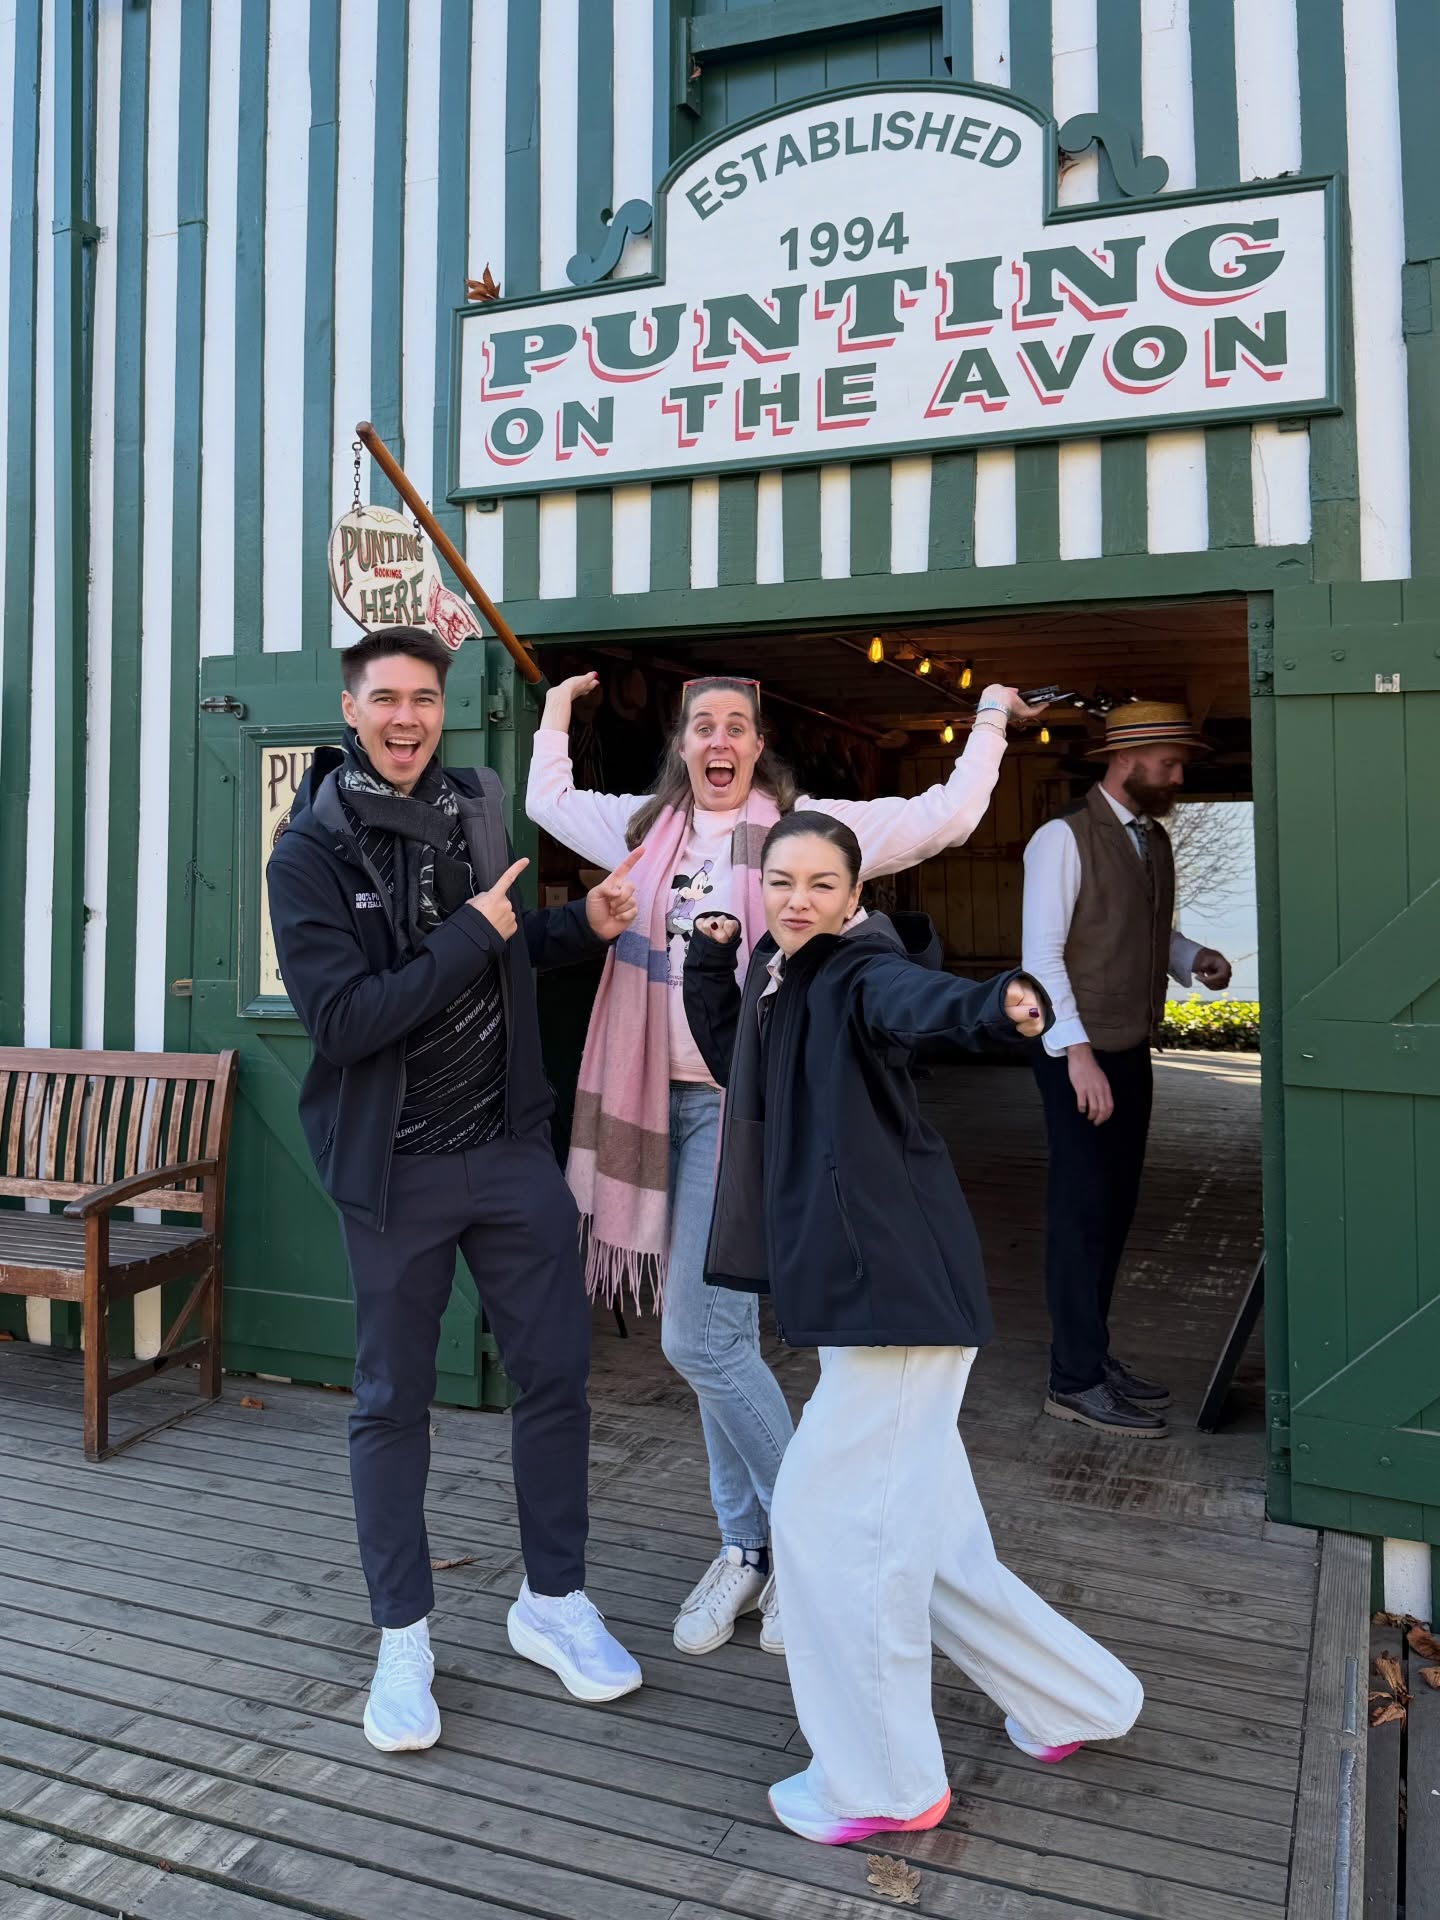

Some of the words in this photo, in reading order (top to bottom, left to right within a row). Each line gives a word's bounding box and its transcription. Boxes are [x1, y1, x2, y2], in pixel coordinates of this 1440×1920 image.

[685, 110, 1021, 220] ESTABLISHED
[778, 211, 910, 271] 1994
[481, 216, 1285, 401] PUNTING
[486, 394, 616, 466] ON
[662, 360, 878, 448] THE
[924, 311, 1290, 419] AVON
[339, 524, 424, 600] PUNTING
[374, 567, 403, 580] BOOKINGS
[360, 570, 426, 626] HERE
[355, 901, 367, 909] NEW
[367, 901, 384, 909] ZEALA
[356, 892, 371, 902] 100%
[372, 892, 380, 901] PU
